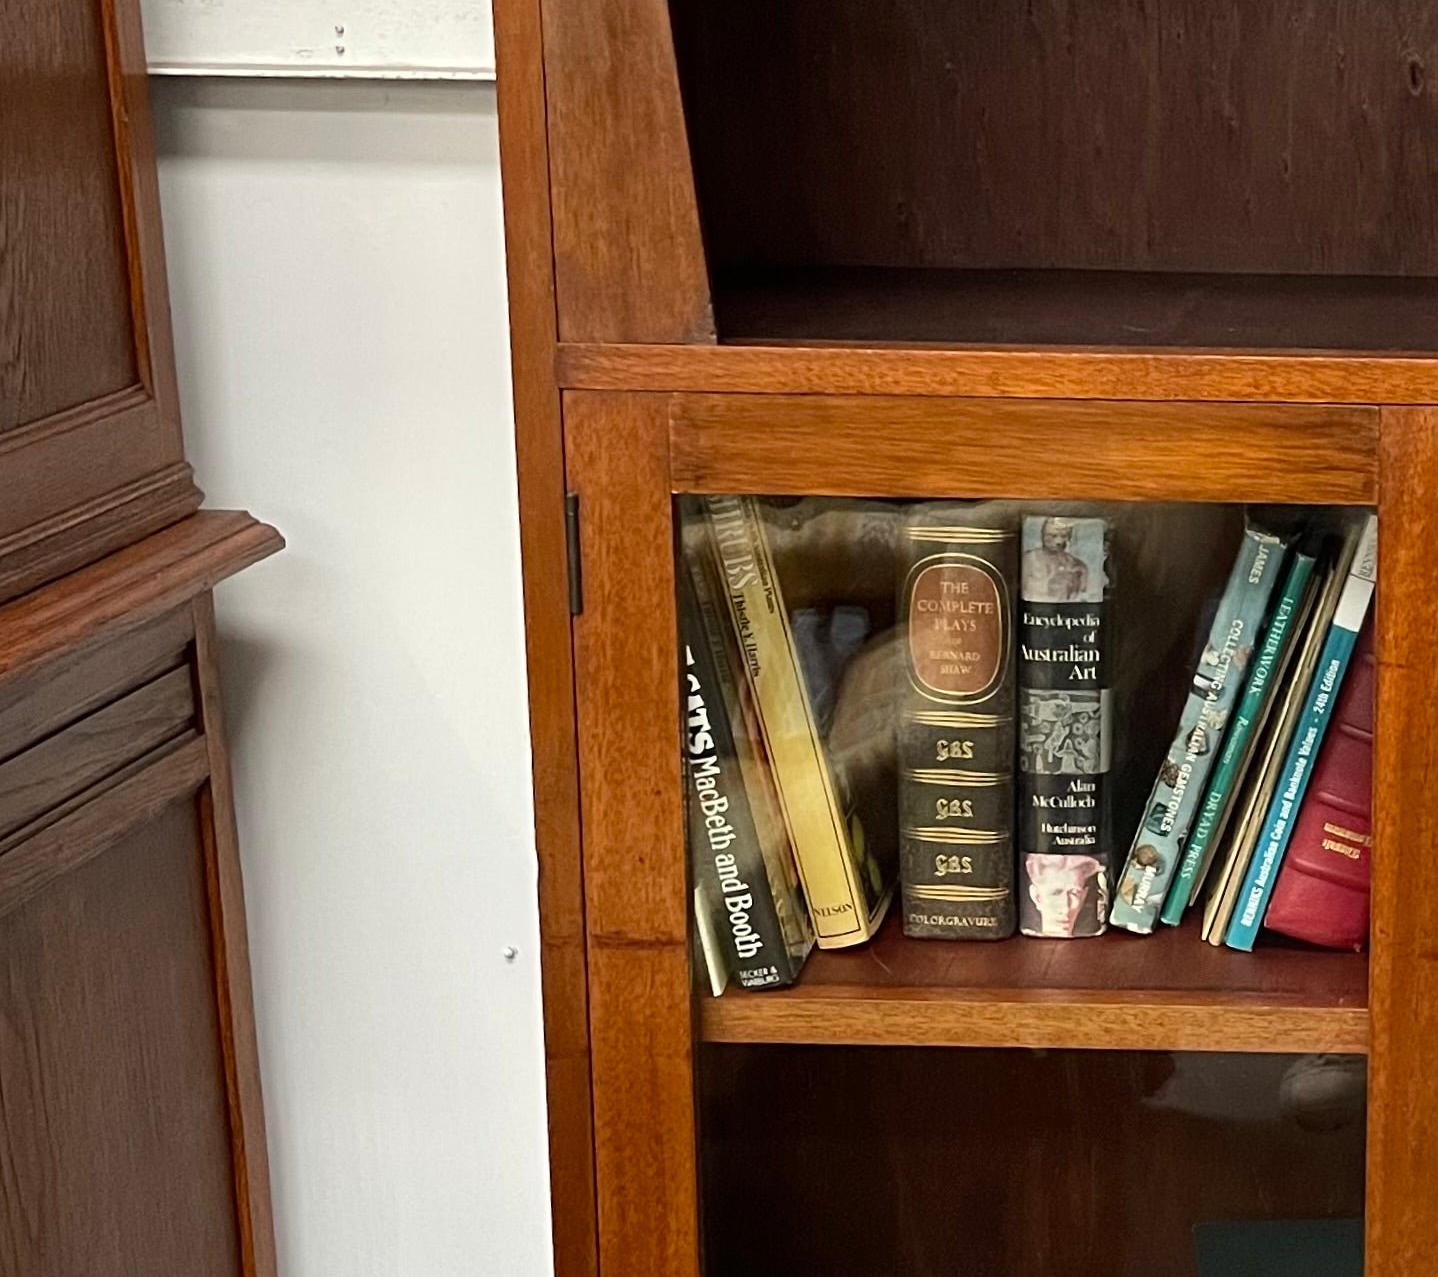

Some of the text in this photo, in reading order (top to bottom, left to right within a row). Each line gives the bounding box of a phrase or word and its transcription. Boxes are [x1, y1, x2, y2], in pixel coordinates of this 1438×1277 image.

[708, 496, 758, 590] HRUBS
[1248, 544, 1270, 584] JAMES
[940, 581, 969, 594] THE
[917, 600, 994, 614] COMPLETE
[934, 617, 976, 632] PLAYS
[1023, 612, 1100, 630] Encyclopedia
[1083, 629, 1098, 643] of
[1249, 597, 1294, 696] LEATHERWORK
[930, 650, 981, 662] BERNARD
[1022, 644, 1100, 662] Australian
[1211, 619, 1244, 690] COLLECTING
[940, 664, 973, 675] SHAW
[1068, 665, 1097, 680] Art
[1320, 659, 1341, 693] Edition
[1312, 688, 1329, 715] 24th
[1298, 726, 1319, 757] Values
[1067, 779, 1095, 792] Alan
[1284, 757, 1308, 801] Banknote
[690, 755, 736, 851] MacBeth
[1032, 795, 1095, 808] McCulloch
[1160, 763, 1193, 832] GEMSTONES
[1279, 799, 1294, 820] and
[1041, 823, 1097, 834] Hutchinson
[1181, 791, 1222, 879] DRYAD PRESS
[1270, 818, 1287, 841] Coin
[1053, 834, 1096, 846] Australia
[715, 853, 749, 893] and
[1254, 841, 1279, 888] Australian
[814, 903, 853, 917] NELSON
[725, 893, 763, 959] Booth
